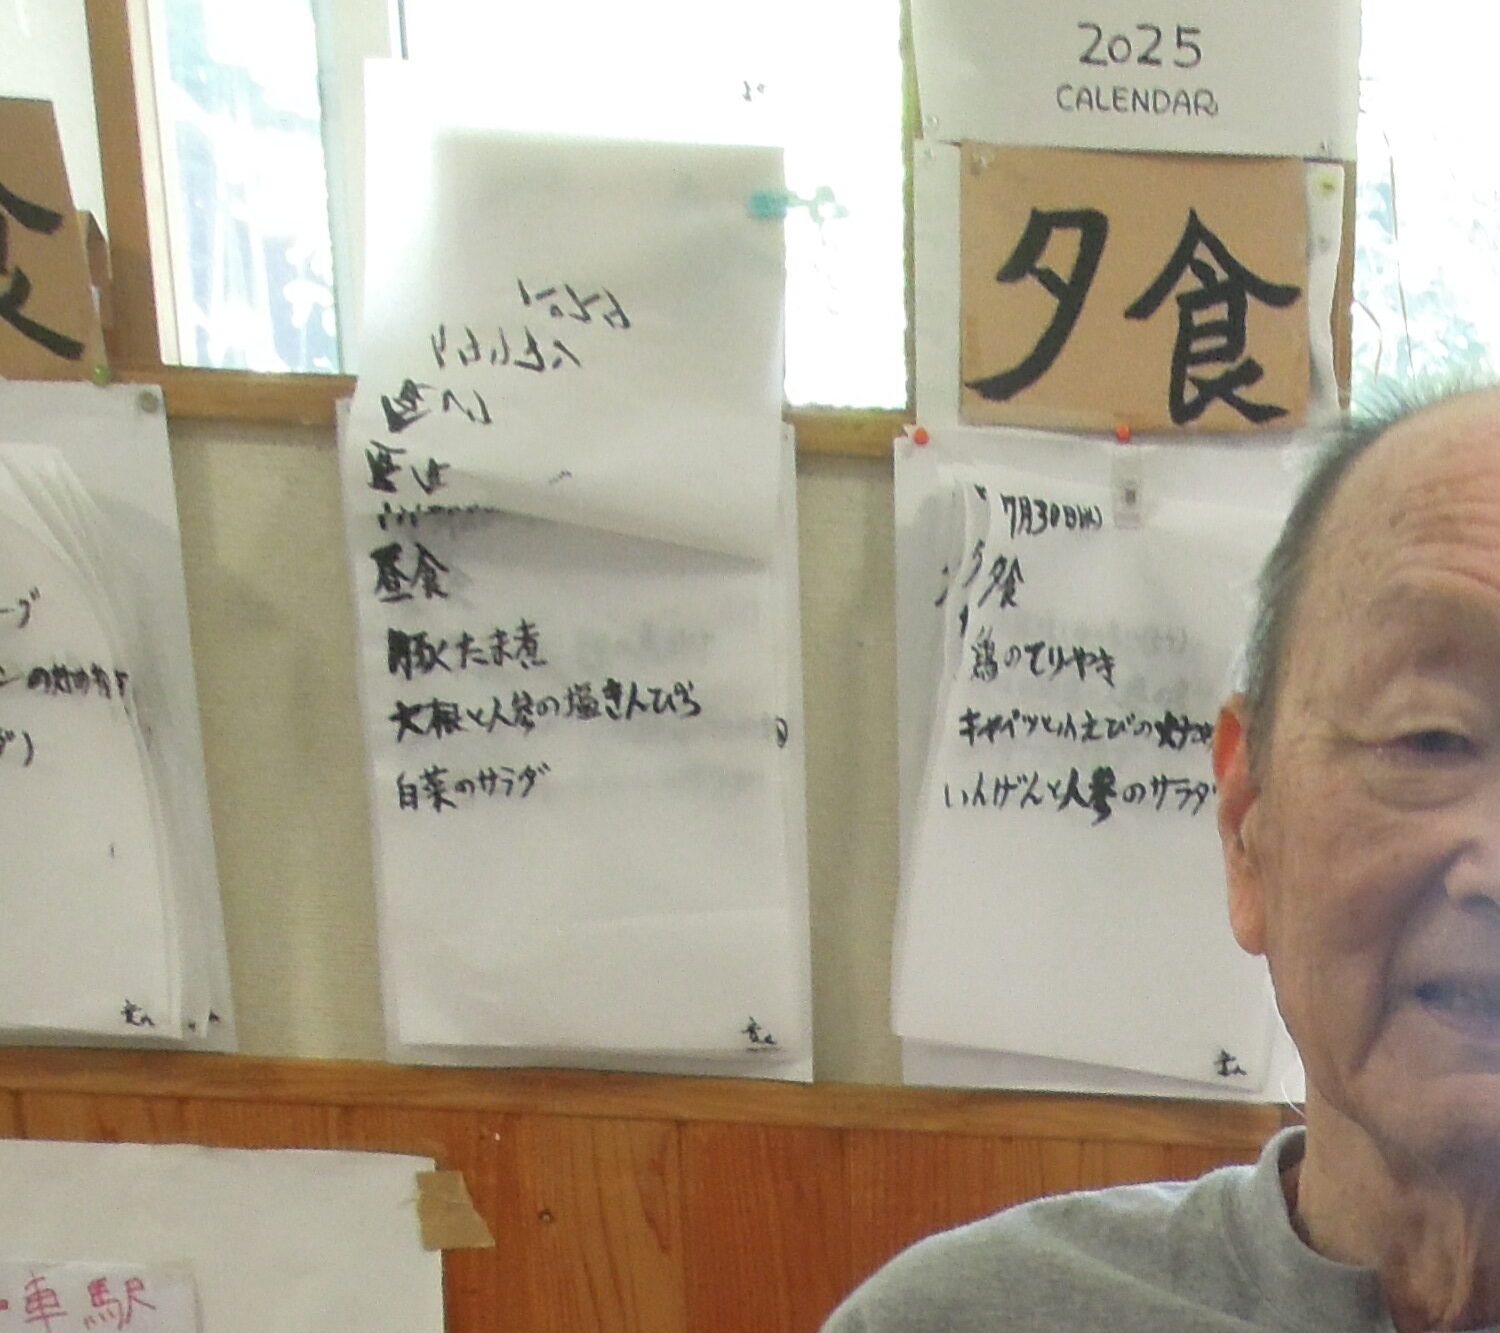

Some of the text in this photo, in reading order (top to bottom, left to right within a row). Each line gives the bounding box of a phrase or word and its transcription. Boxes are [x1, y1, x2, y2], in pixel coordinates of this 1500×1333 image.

[1077, 22, 1202, 69] 2025
[1056, 83, 1219, 117] CALENDAR
[964, 206, 1301, 426] 夕食
[369, 542, 450, 603] 昼食
